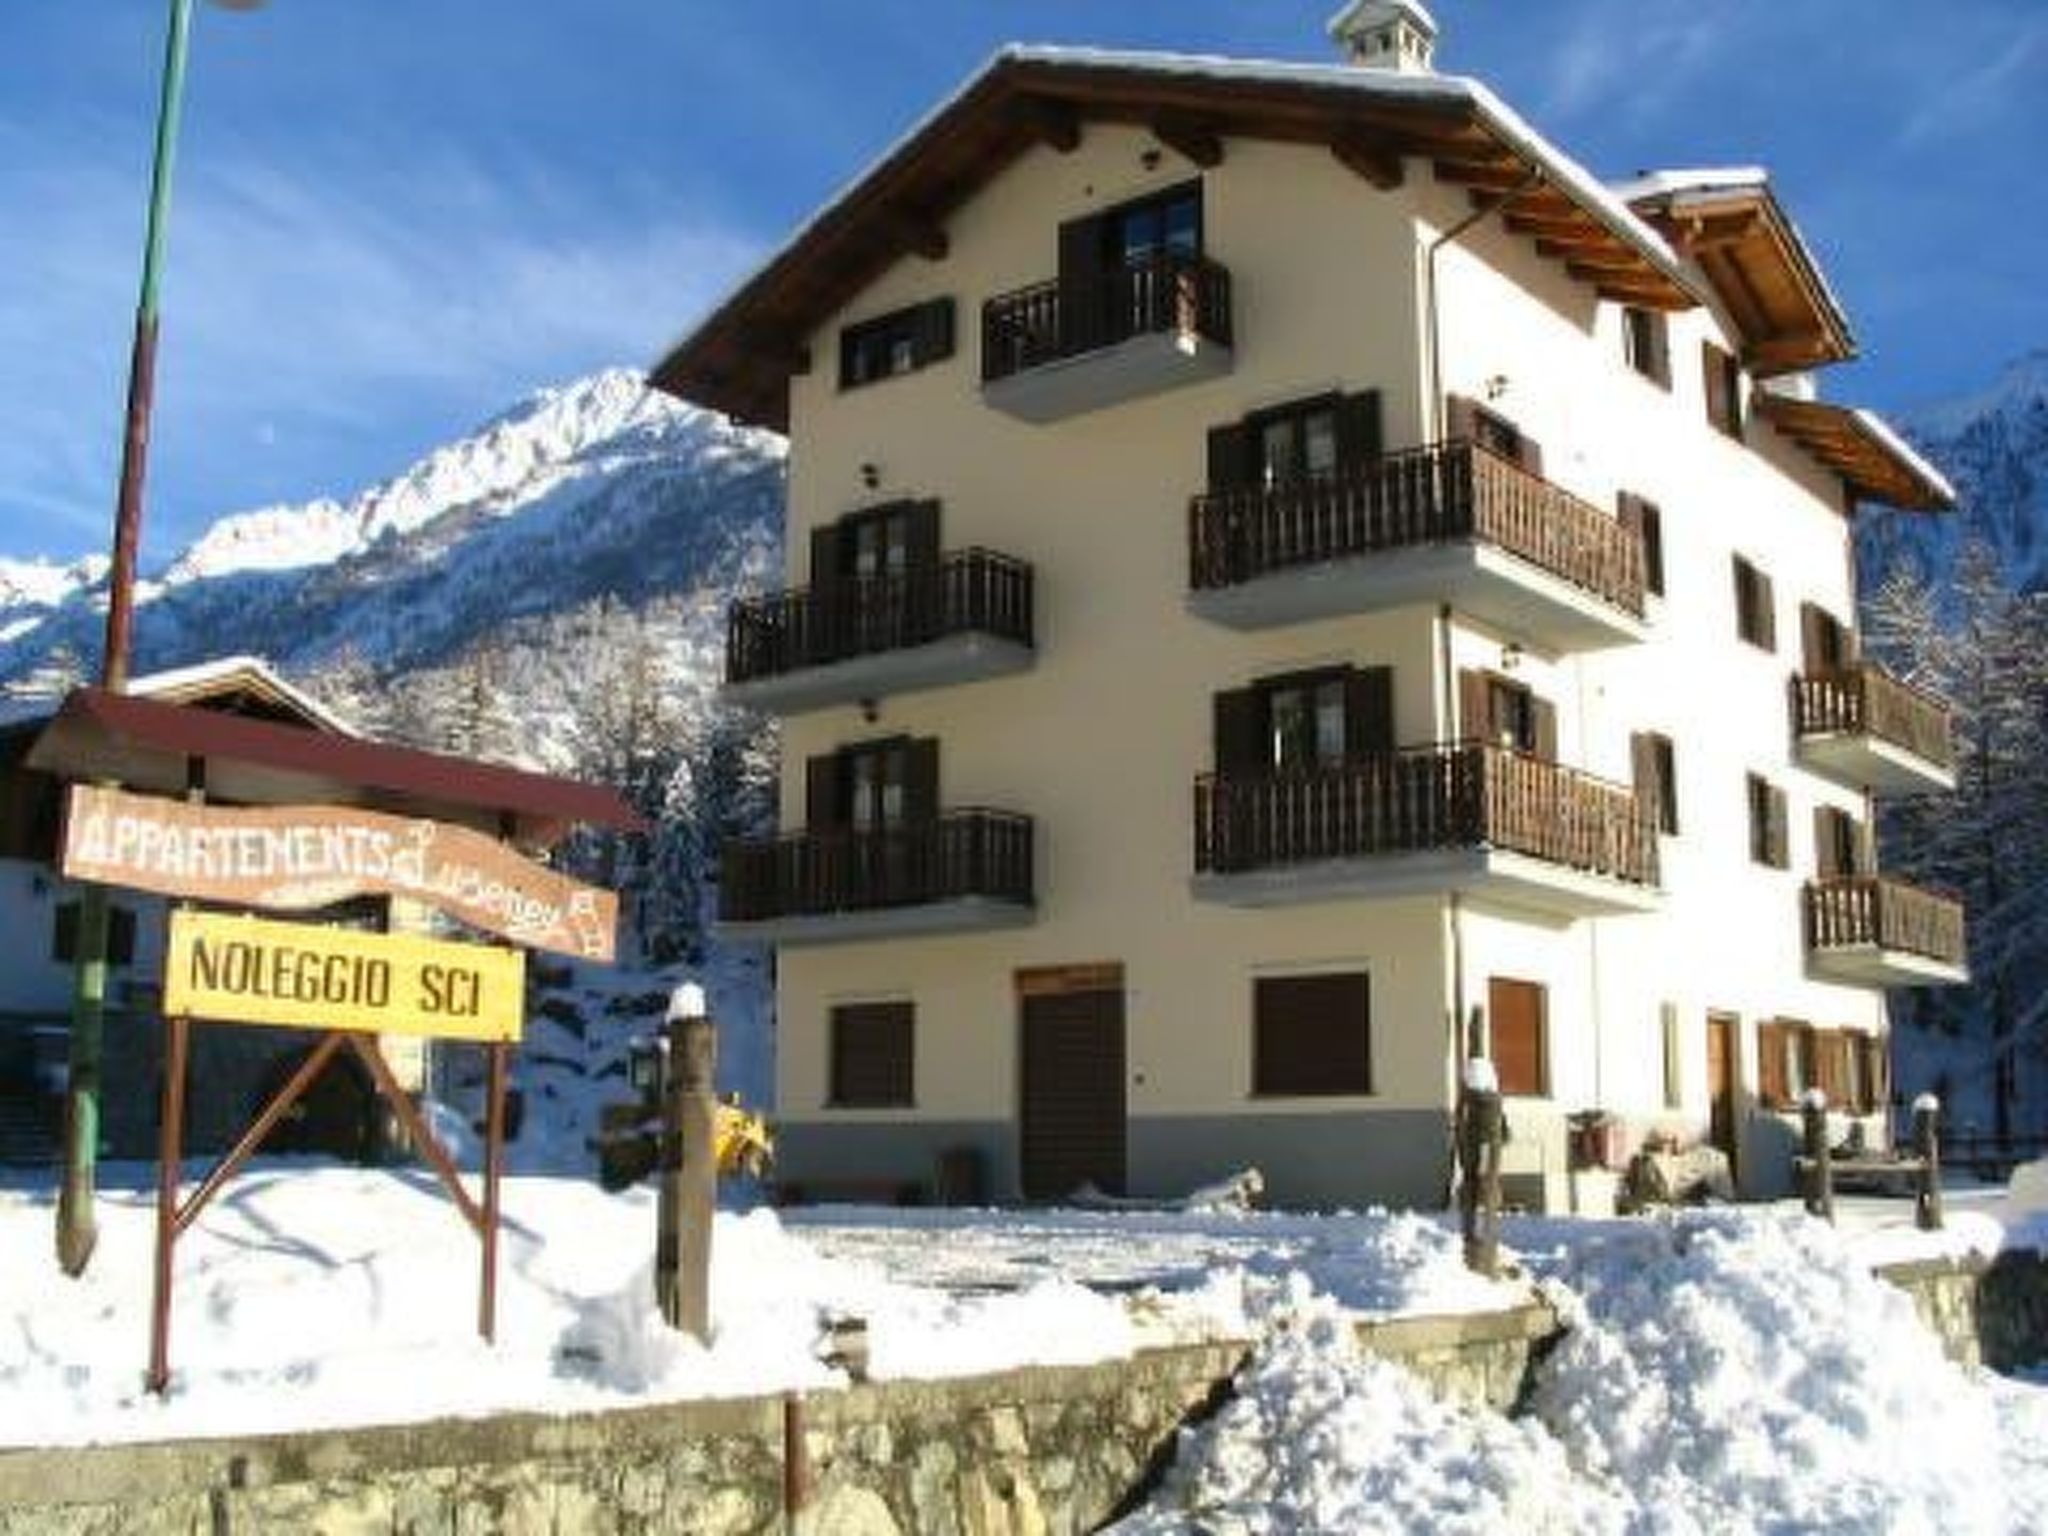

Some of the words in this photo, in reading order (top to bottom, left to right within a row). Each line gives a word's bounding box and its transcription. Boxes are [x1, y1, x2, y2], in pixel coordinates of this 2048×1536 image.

[78, 814, 391, 878] APPARTEMENTS
[191, 936, 390, 1007] NOLEGGIO
[420, 963, 480, 1017] SCI
